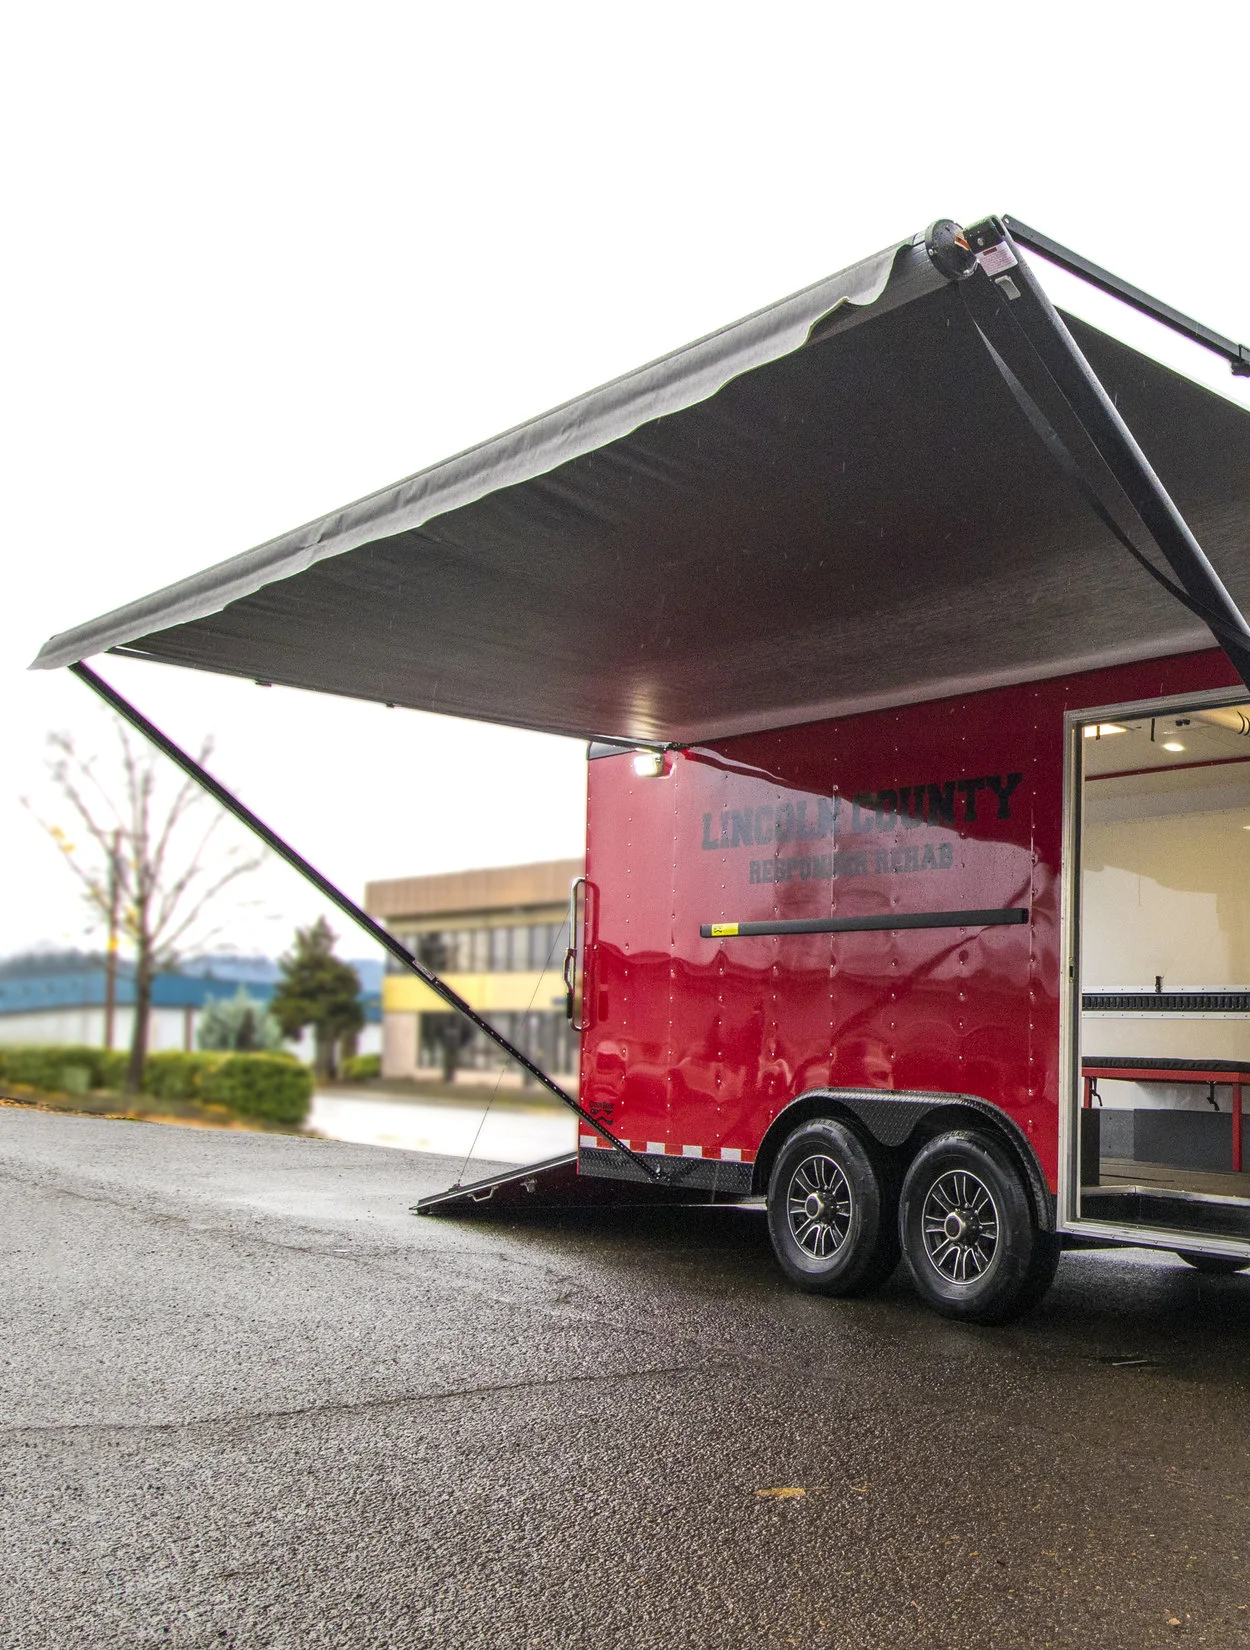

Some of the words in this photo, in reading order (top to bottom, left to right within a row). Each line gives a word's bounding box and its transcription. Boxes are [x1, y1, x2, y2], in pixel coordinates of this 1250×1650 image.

[701, 797, 840, 850] LINCOLN
[852, 772, 1023, 834] COUNTY
[874, 842, 953, 874] REHAB
